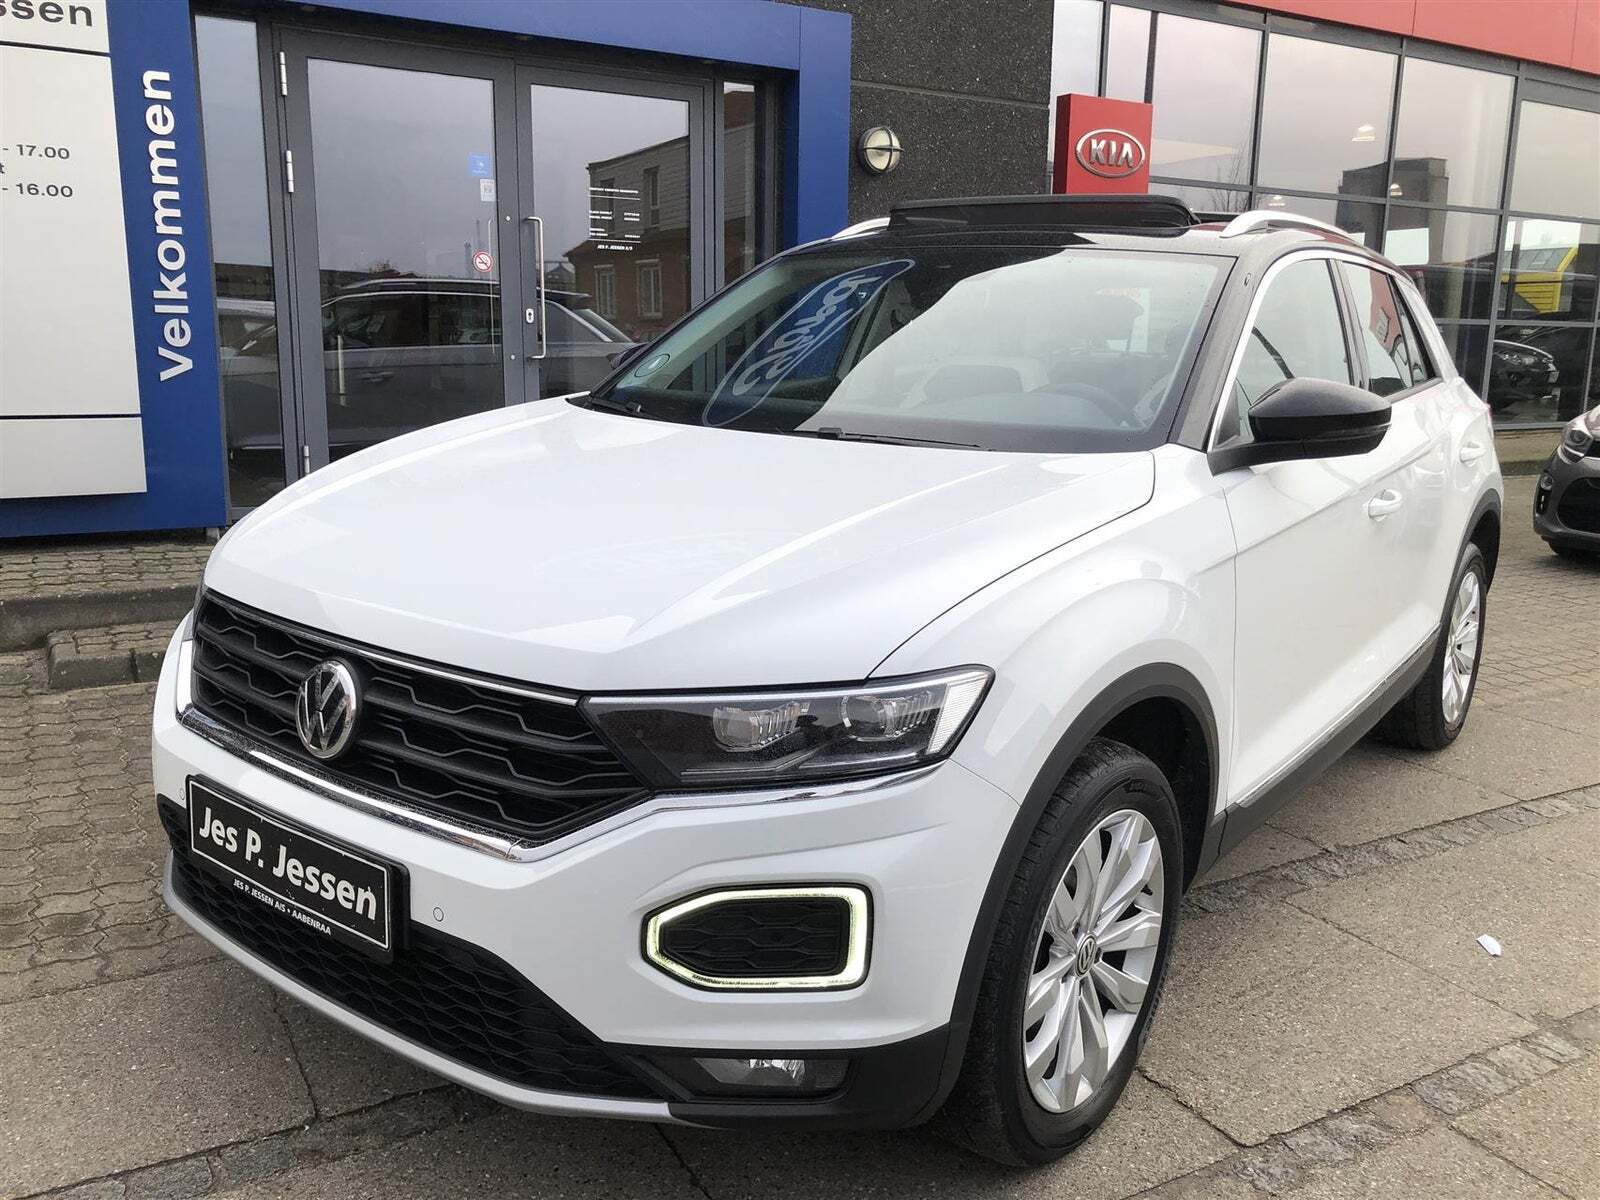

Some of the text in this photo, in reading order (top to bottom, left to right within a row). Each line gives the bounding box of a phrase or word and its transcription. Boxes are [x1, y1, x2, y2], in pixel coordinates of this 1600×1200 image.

[0, 0, 93, 27] sen
[16, 144, 70, 160] 17.00
[1090, 138, 1134, 168] KIA
[16, 183, 73, 198] 16.00
[142, 69, 193, 382] Velkommen
[199, 807, 377, 921] Jes P. Jessen
[233, 878, 244, 891] JES
[244, 884, 251, 894] P.
[251, 890, 274, 905] JESSEN
[292, 910, 332, 936] AABENRAA
